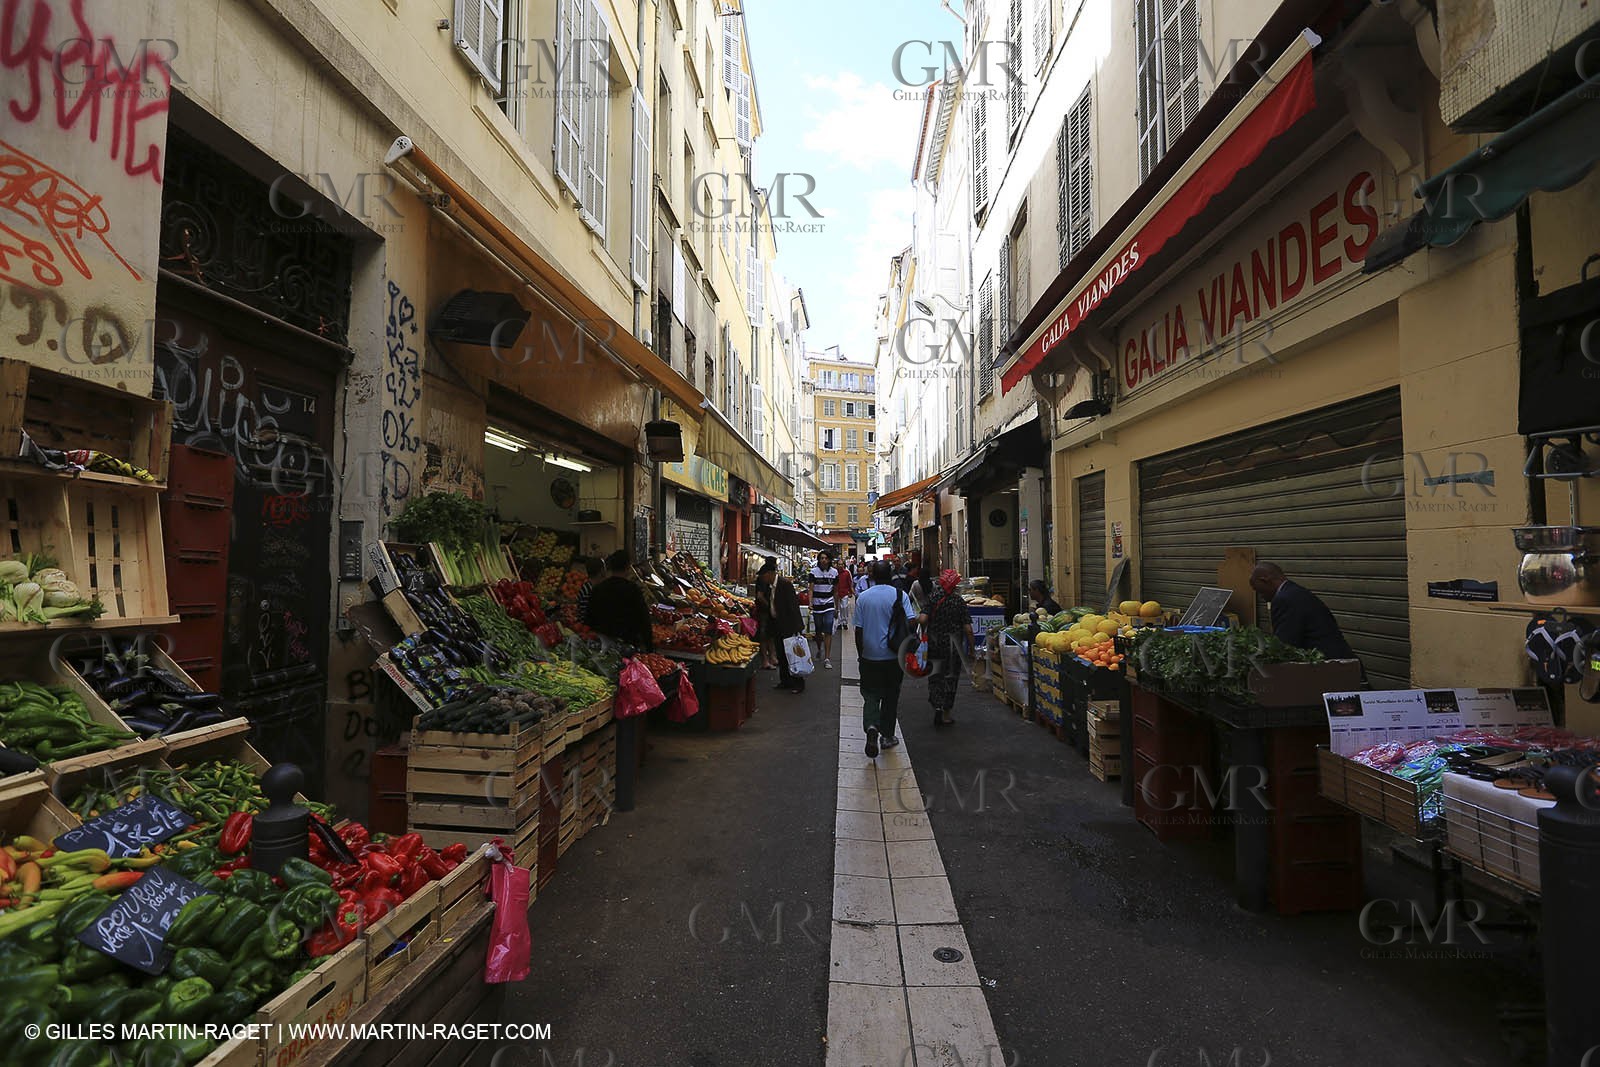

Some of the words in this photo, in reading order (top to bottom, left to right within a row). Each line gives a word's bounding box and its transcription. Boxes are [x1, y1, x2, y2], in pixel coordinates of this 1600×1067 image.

[1041, 313, 1071, 354] GALIA
[1076, 241, 1140, 318] VIANDES
[1124, 304, 1189, 389] GALIA
[1198, 170, 1379, 346] VIANDES
[303, 398, 316, 414] 14
